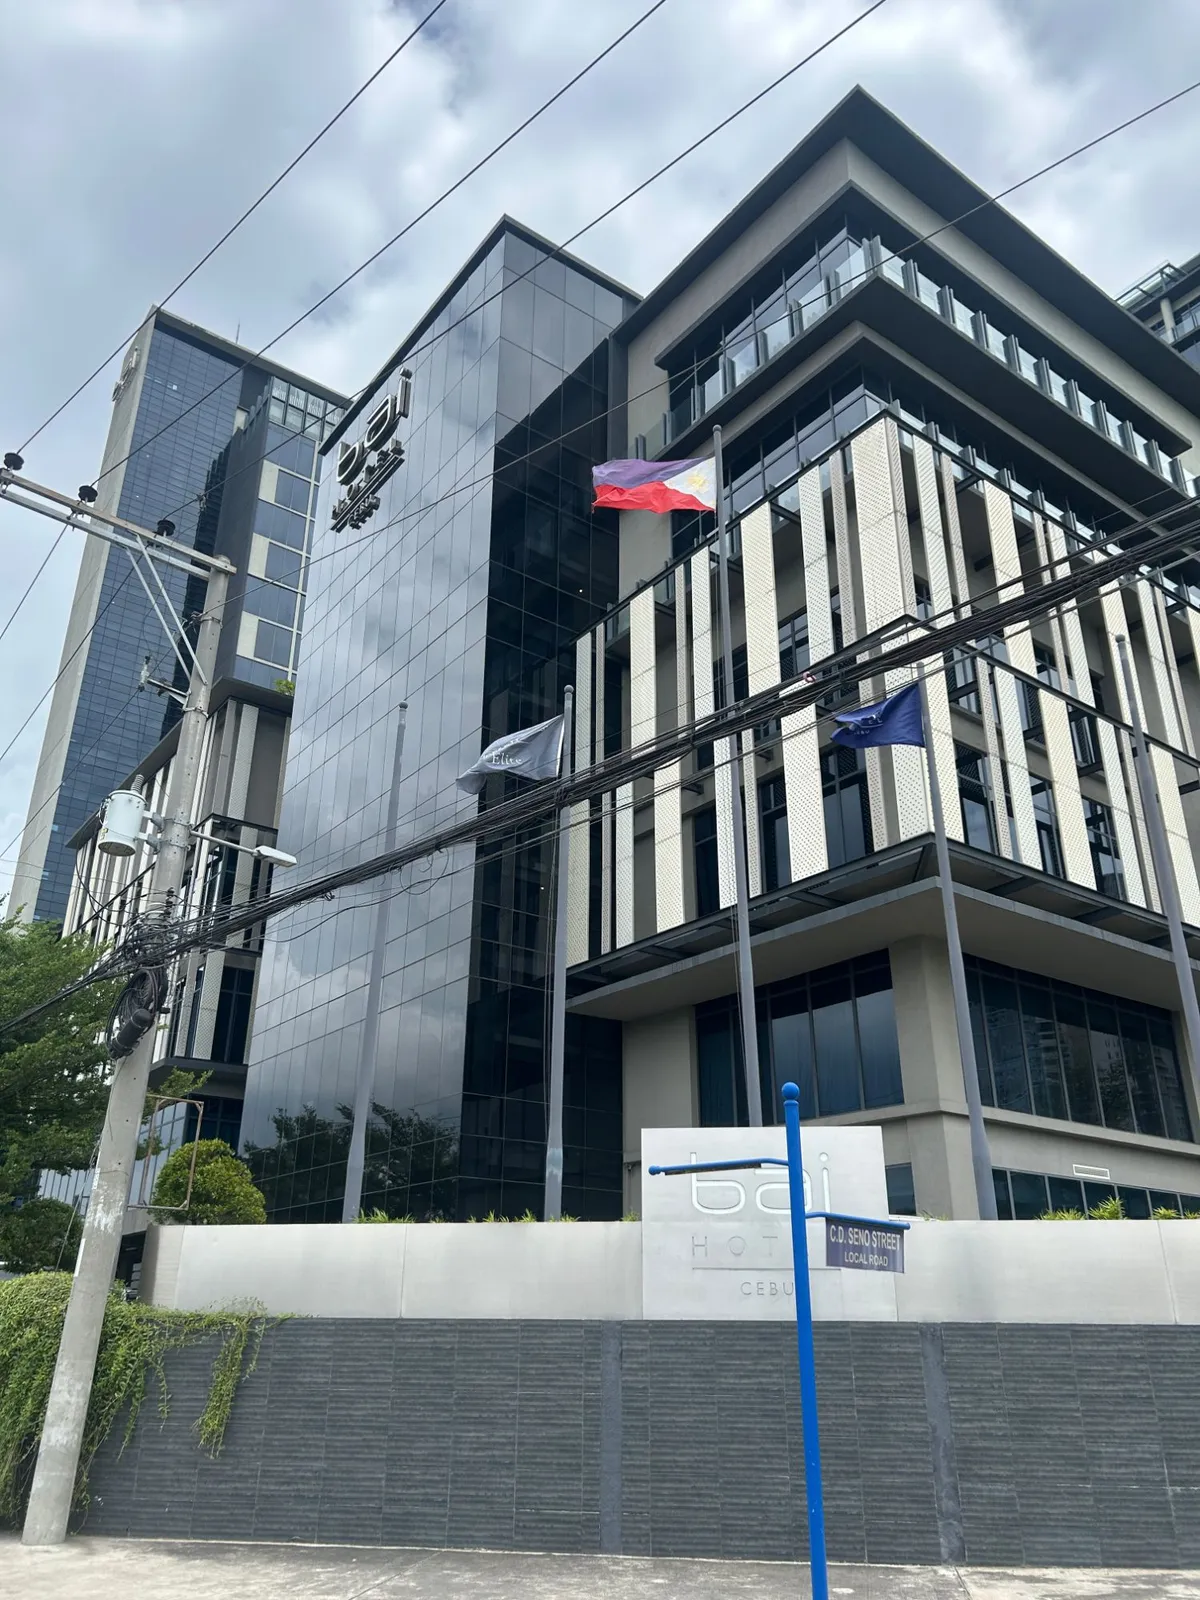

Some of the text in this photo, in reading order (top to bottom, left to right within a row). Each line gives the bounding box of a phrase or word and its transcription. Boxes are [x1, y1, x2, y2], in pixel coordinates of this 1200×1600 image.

[336, 367, 412, 486] bai
[690, 1152, 831, 1215] bai
[691, 1236, 801, 1257] HOT
[829, 1225, 901, 1251] C.D. SENO STREET
[844, 1251, 888, 1267] LOCAL ROAD
[740, 1281, 794, 1296] CEBU
